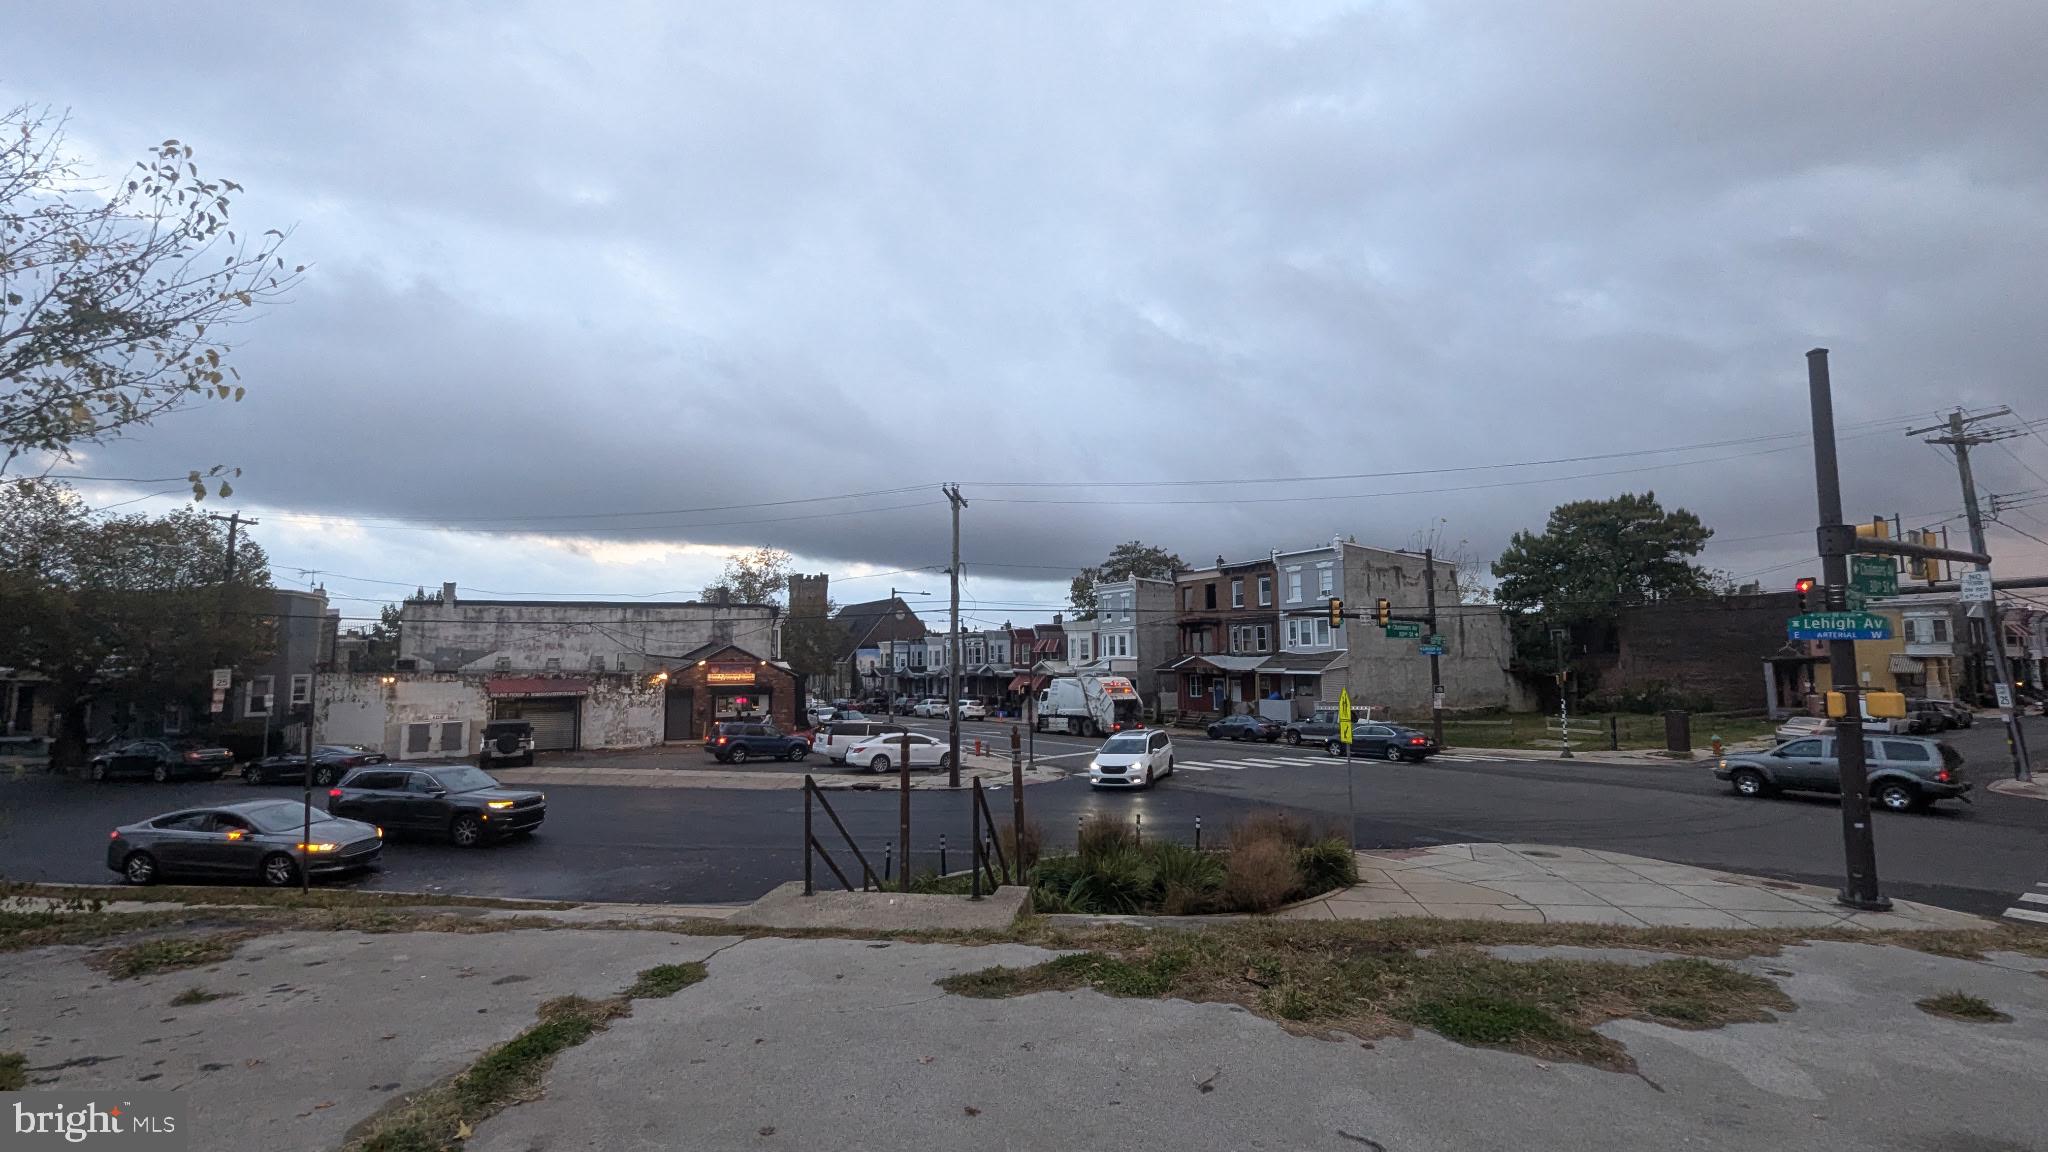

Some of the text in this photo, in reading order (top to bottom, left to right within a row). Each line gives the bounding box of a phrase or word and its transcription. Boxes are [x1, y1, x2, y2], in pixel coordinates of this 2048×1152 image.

[1804, 618, 1883, 630] Lehigh Av
[2000, 696, 2010, 705] 25
